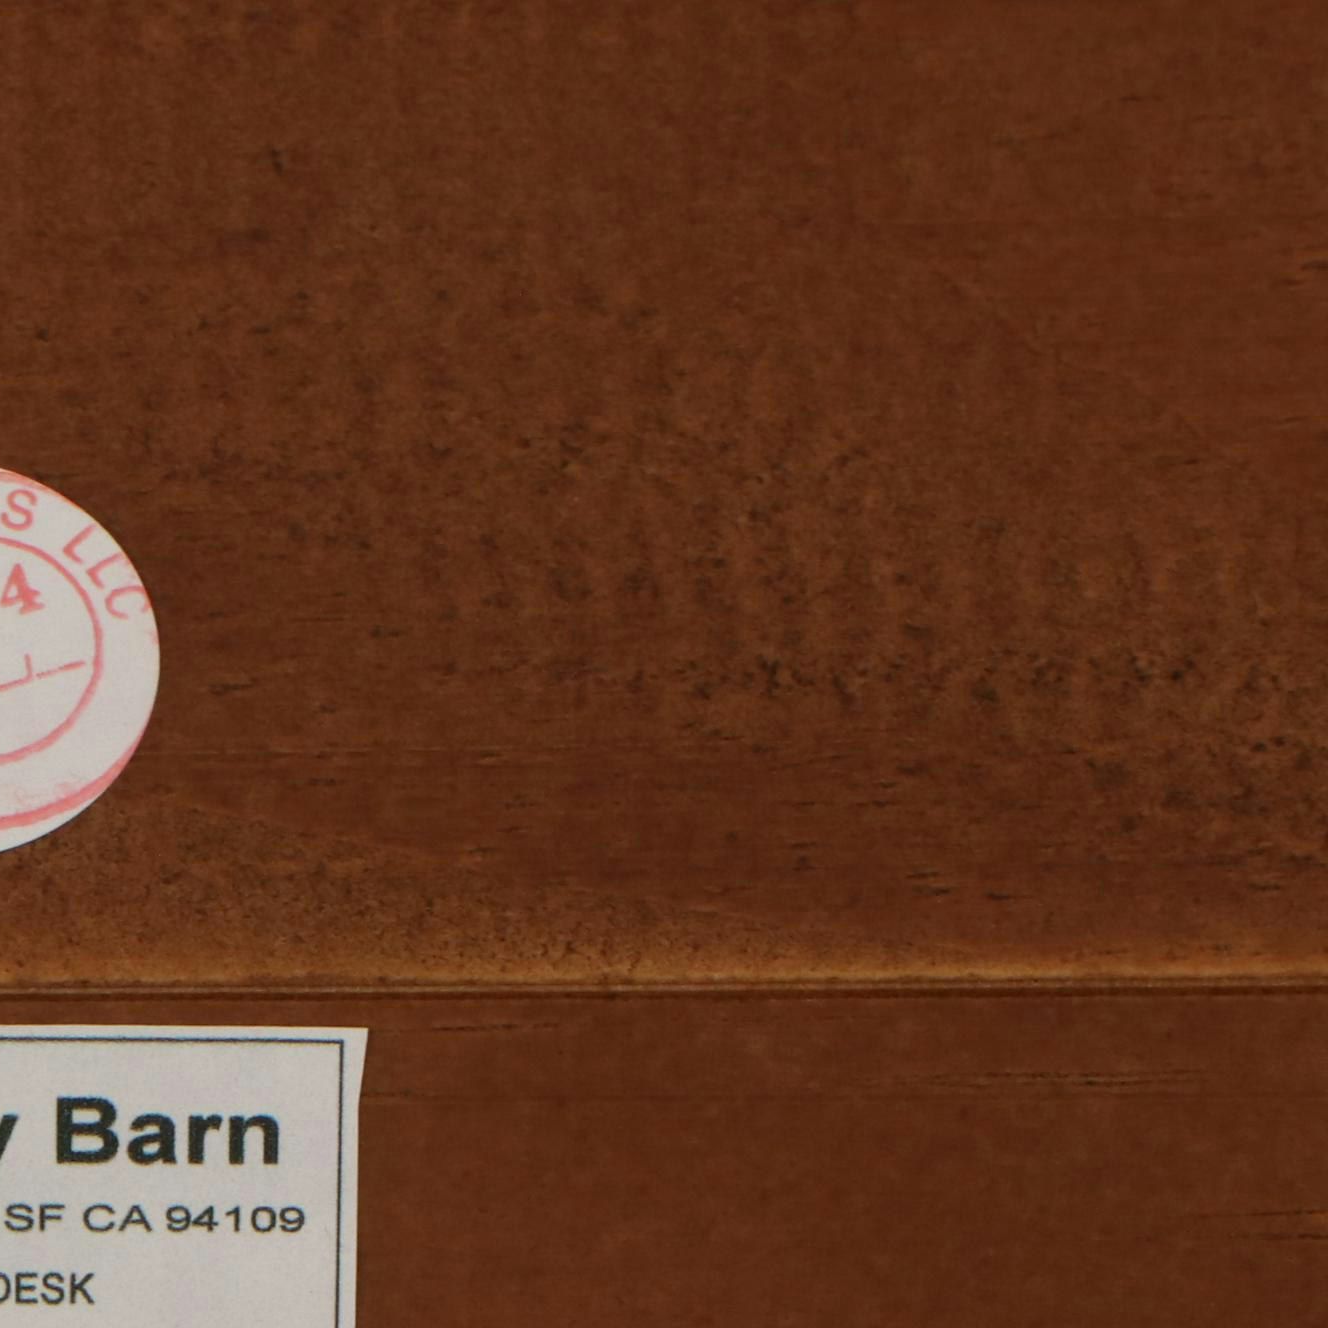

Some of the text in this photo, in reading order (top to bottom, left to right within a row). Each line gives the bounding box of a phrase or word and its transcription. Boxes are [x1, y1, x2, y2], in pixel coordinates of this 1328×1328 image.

[63, 523, 149, 620] LLC
[55, 1096, 280, 1167] Barn
[3, 1202, 66, 1233] SF
[82, 1203, 153, 1233] CA
[165, 1204, 306, 1234] 94109
